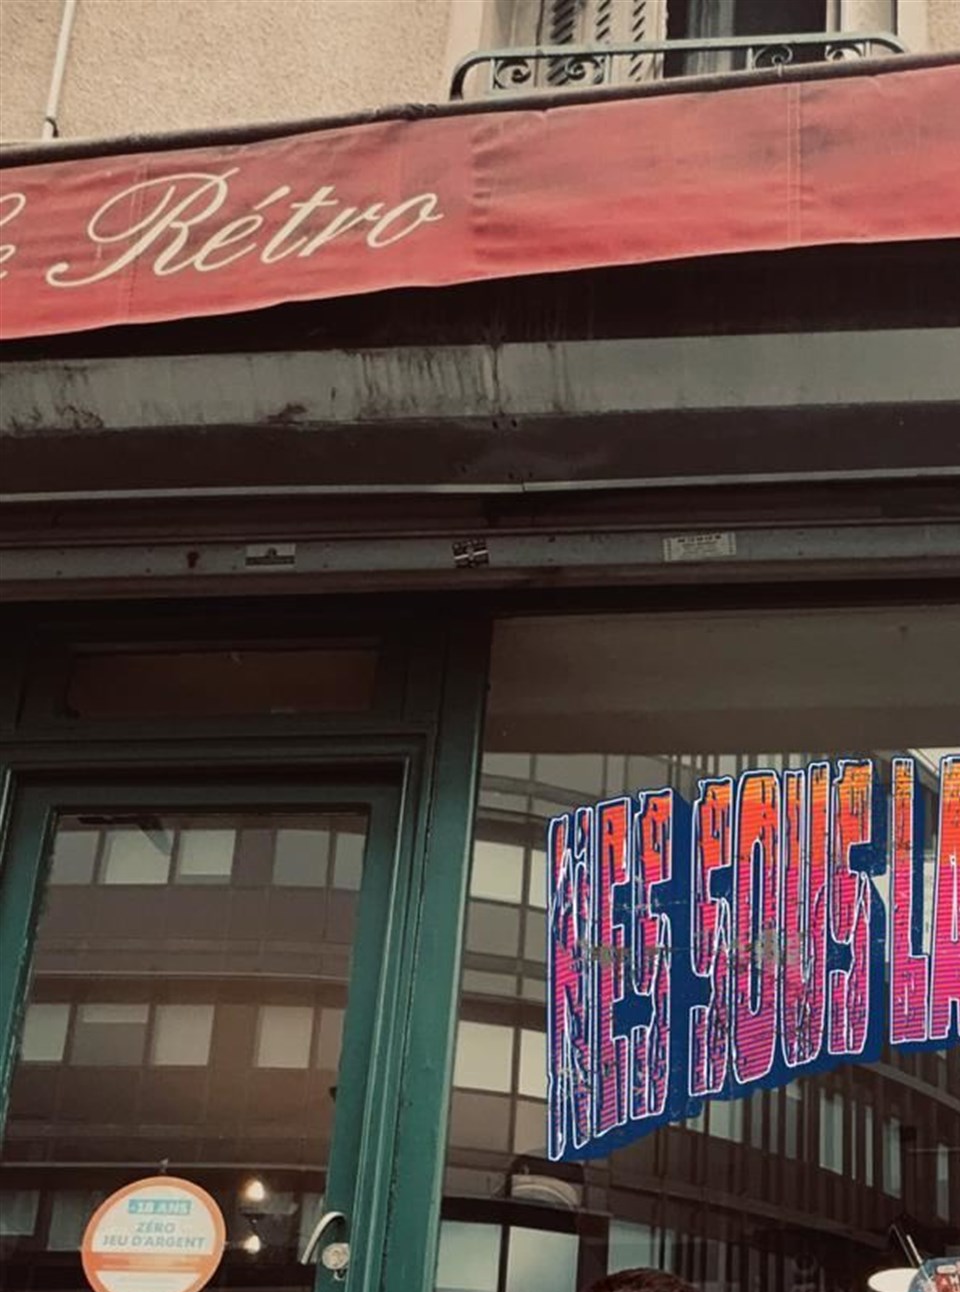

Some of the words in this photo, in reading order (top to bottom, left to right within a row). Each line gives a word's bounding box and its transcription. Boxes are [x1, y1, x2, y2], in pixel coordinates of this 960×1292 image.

[46, 167, 444, 287] Rétro
[102, 1235, 129, 1247] JEU
[131, 1235, 206, 1249] D'ARGENT
